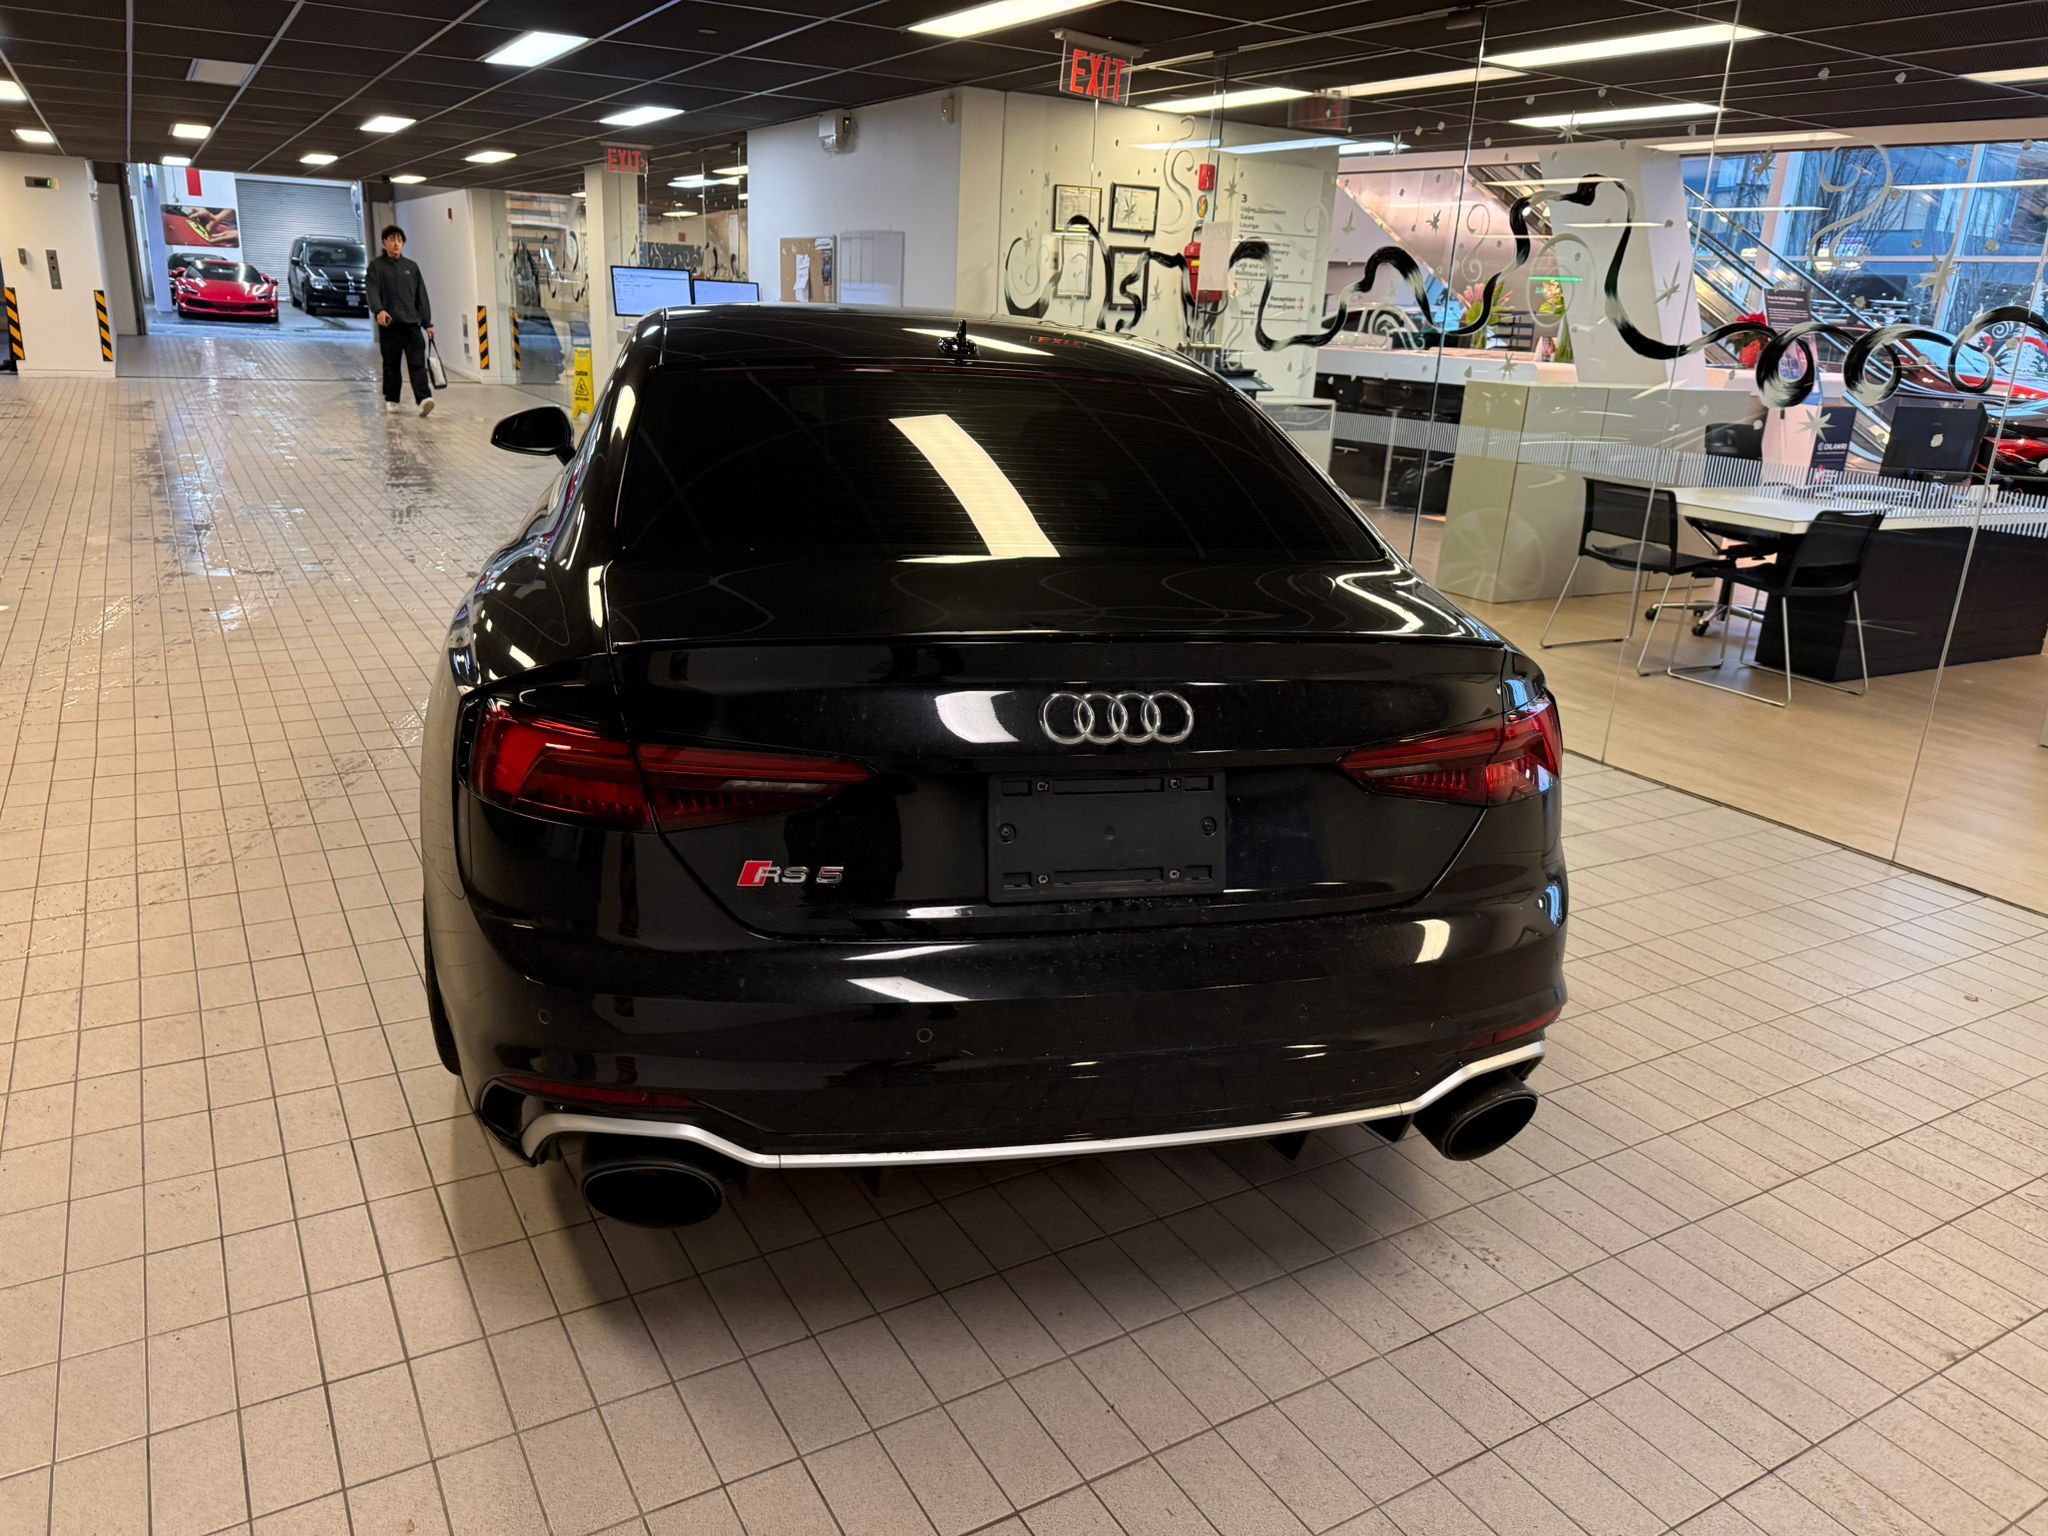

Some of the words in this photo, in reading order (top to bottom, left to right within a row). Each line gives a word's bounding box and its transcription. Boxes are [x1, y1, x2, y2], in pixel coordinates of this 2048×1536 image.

[1069, 48, 1127, 103] EXIT
[607, 148, 641, 173] EXIT
[1241, 193, 1248, 203] 3
[1240, 213, 1255, 221] Sales
[1239, 221, 1259, 230] Lounge
[1270, 295, 1296, 303] Reception
[753, 866, 809, 883] RS
[815, 866, 844, 883] 5
